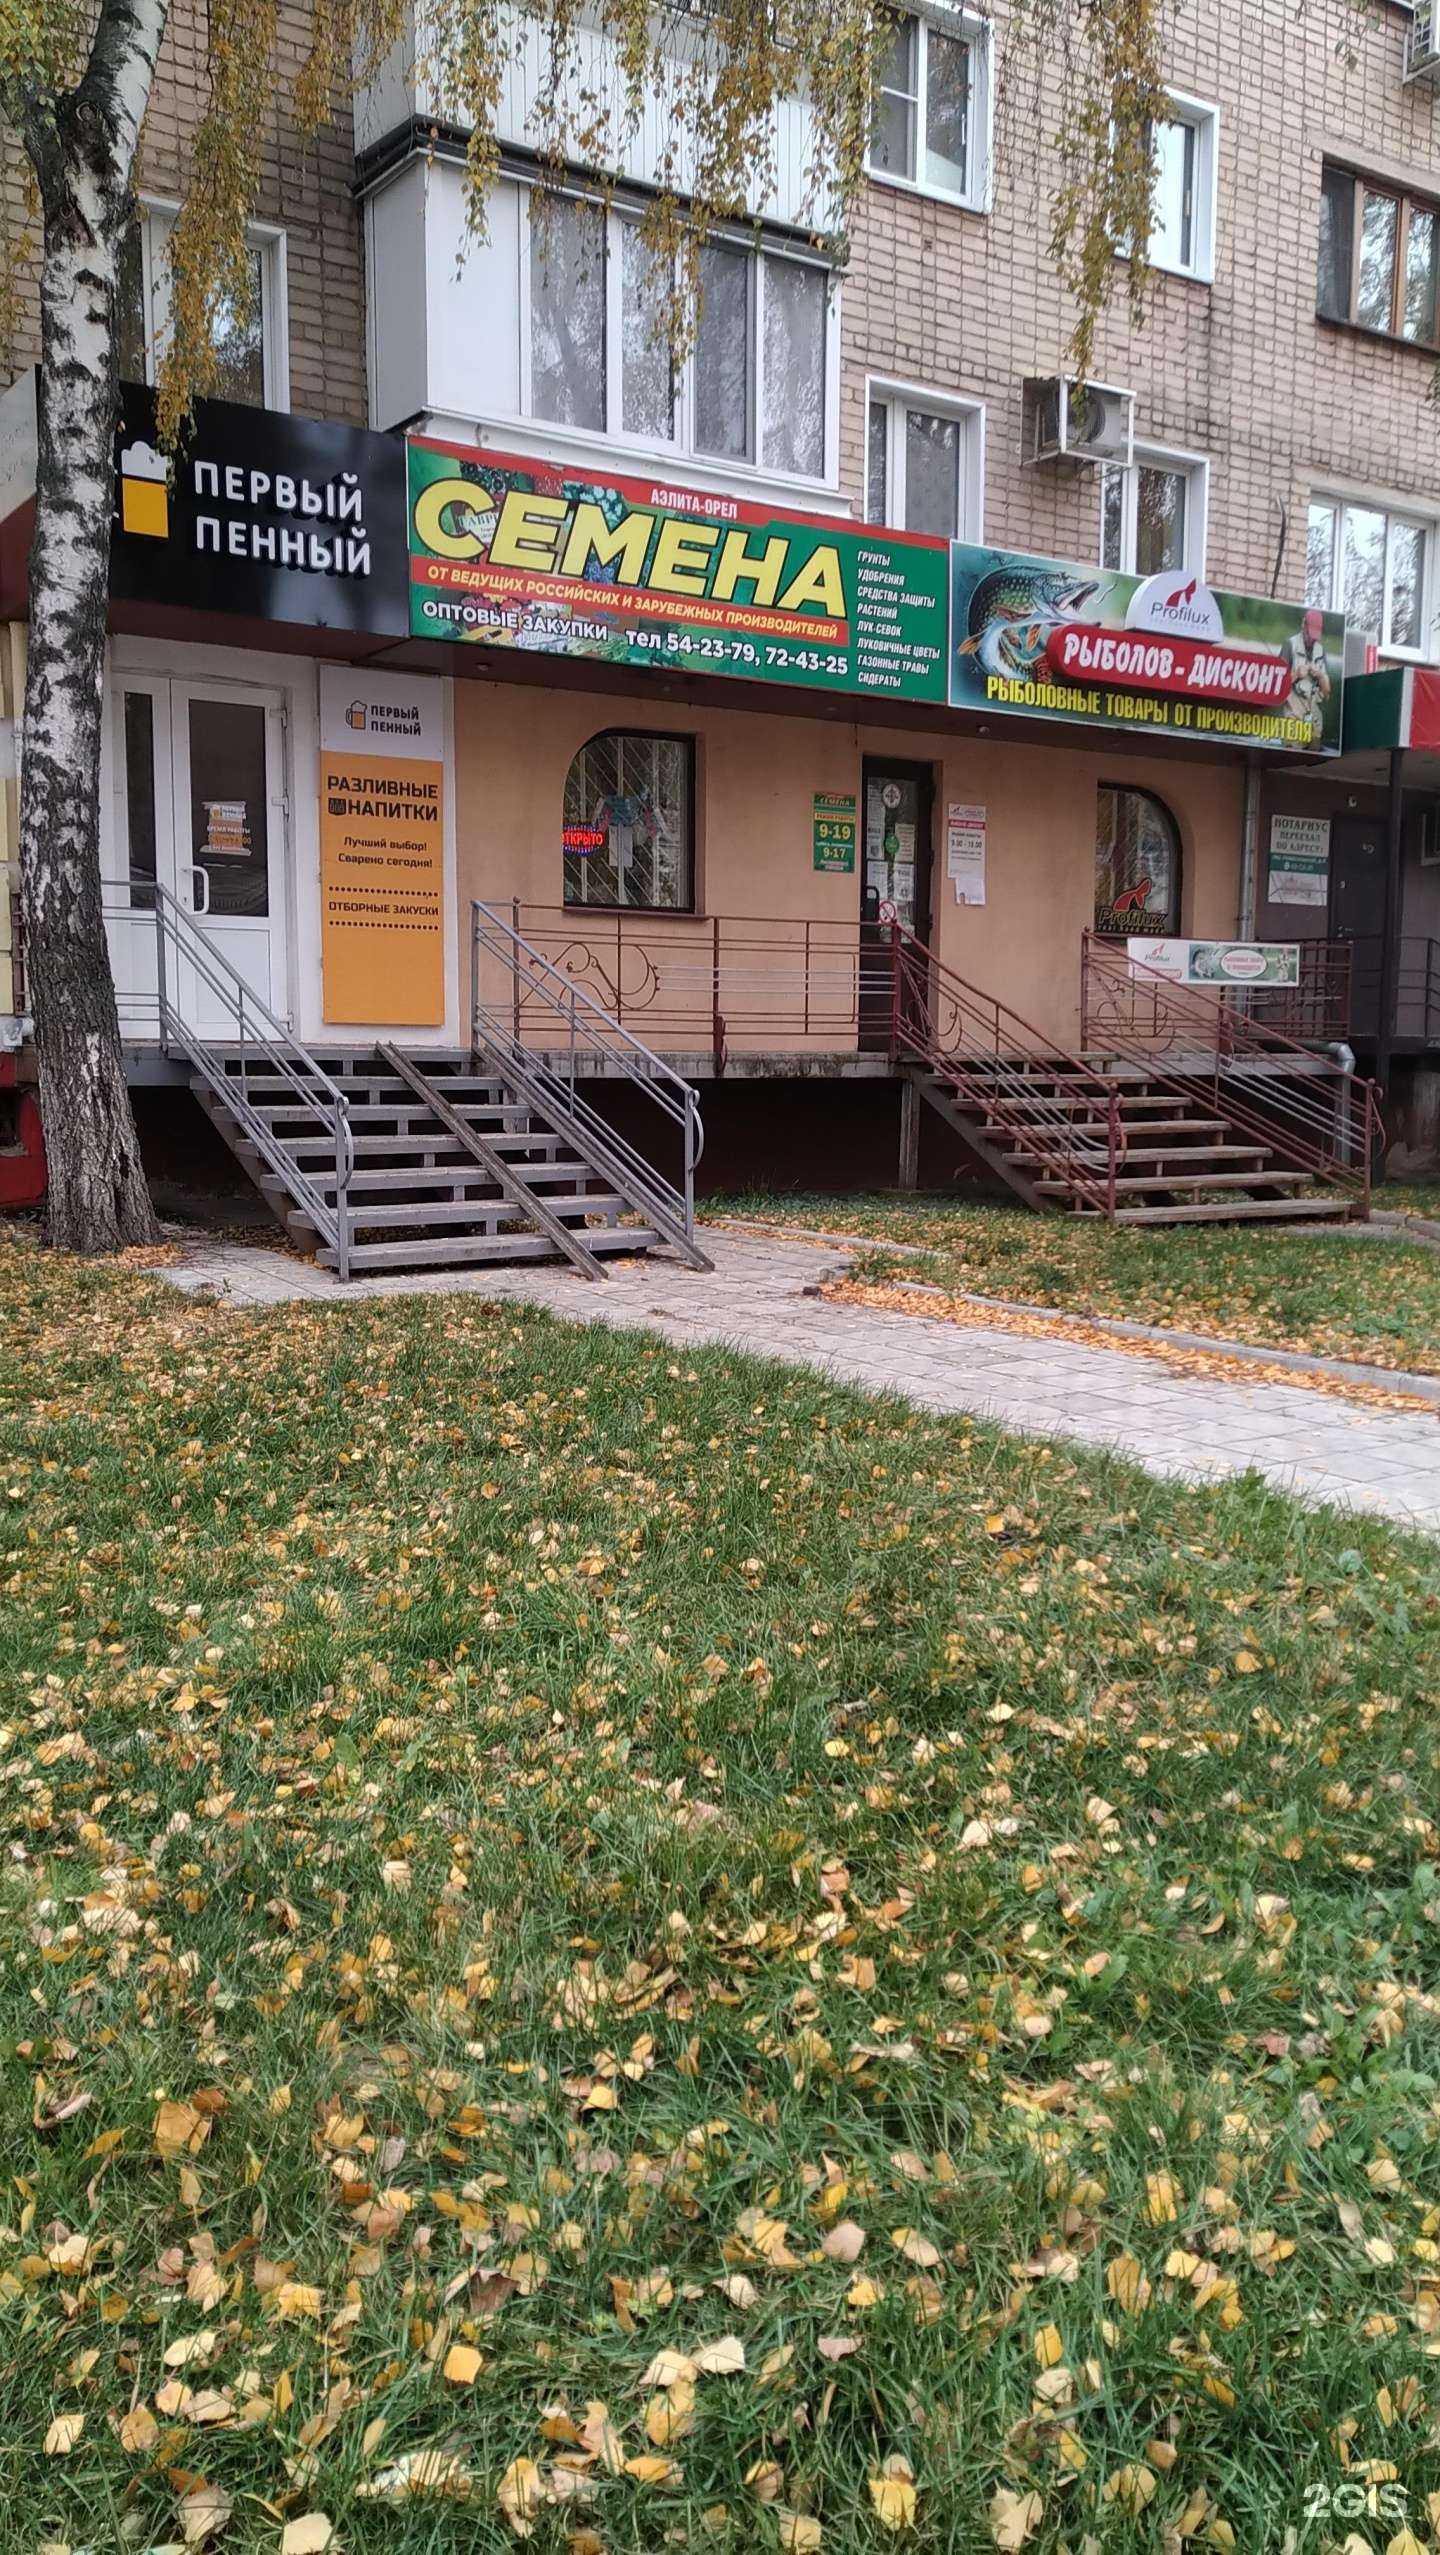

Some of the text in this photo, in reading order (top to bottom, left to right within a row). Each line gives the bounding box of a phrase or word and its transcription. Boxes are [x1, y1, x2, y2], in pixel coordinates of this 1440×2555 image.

[194, 460, 362, 522] ПЕРВЫЙ
[651, 488, 738, 519] АЭЛИТА-ОРЕЛ
[196, 515, 371, 576] ПЕННЫЙ
[414, 477, 848, 620] СЕМЕНА
[857, 551, 891, 567] ГРУНТЫ
[857, 569, 905, 587] УДОБРЕНИЯ
[427, 565, 838, 639] ОТ ВЕДУЩИХ РОССИЙСКИХ И ЗАРУБЕЖНЫХ ПРОИЗВОДИТЕЛЕЙ
[857, 586, 936, 608] СРЕДСТВА ЗАЩИТЫ
[422, 600, 609, 641] ОПТОВЫЕ ЗАКУПКИ
[857, 602, 898, 620] РАСТЕНИЙ
[1151, 601, 1210, 625] Profilux
[857, 620, 903, 637] ЛУК-СЕВОК
[626, 629, 849, 675] тел 54-23-79, 72-43-25
[857, 638, 941, 660] ЛУКОВИЧНЫЕ ЦВЕТЫ
[857, 655, 929, 675] ГАЗОННЫЕ ТРАВЫ
[1063, 633, 1174, 680] РЫБОЛОВ
[1187, 653, 1288, 696] ДИСКОНТ
[858, 672, 901, 688] СИДЕРАТЫ
[370, 704, 419, 720] ПЕРВЫЙ
[987, 675, 1313, 743] РЫБОЛОВНЫЕ ТОВАРЫ ОТ ПРОИЗВОДИТЕЛЯ
[370, 720, 421, 736] ПЕННЫЙ
[327, 775, 438, 799] РАЗЛИВНЫЕ
[348, 799, 438, 821] НАПИТКИ
[819, 823, 851, 840] 9-19
[1274, 817, 1328, 832] НОТАРИУС
[344, 836, 427, 851] Лучший выбор!
[338, 853, 433, 868] Сварено сегодня!
[328, 901, 439, 916] ОТБОРНЫЕ ЗАКУСКИ
